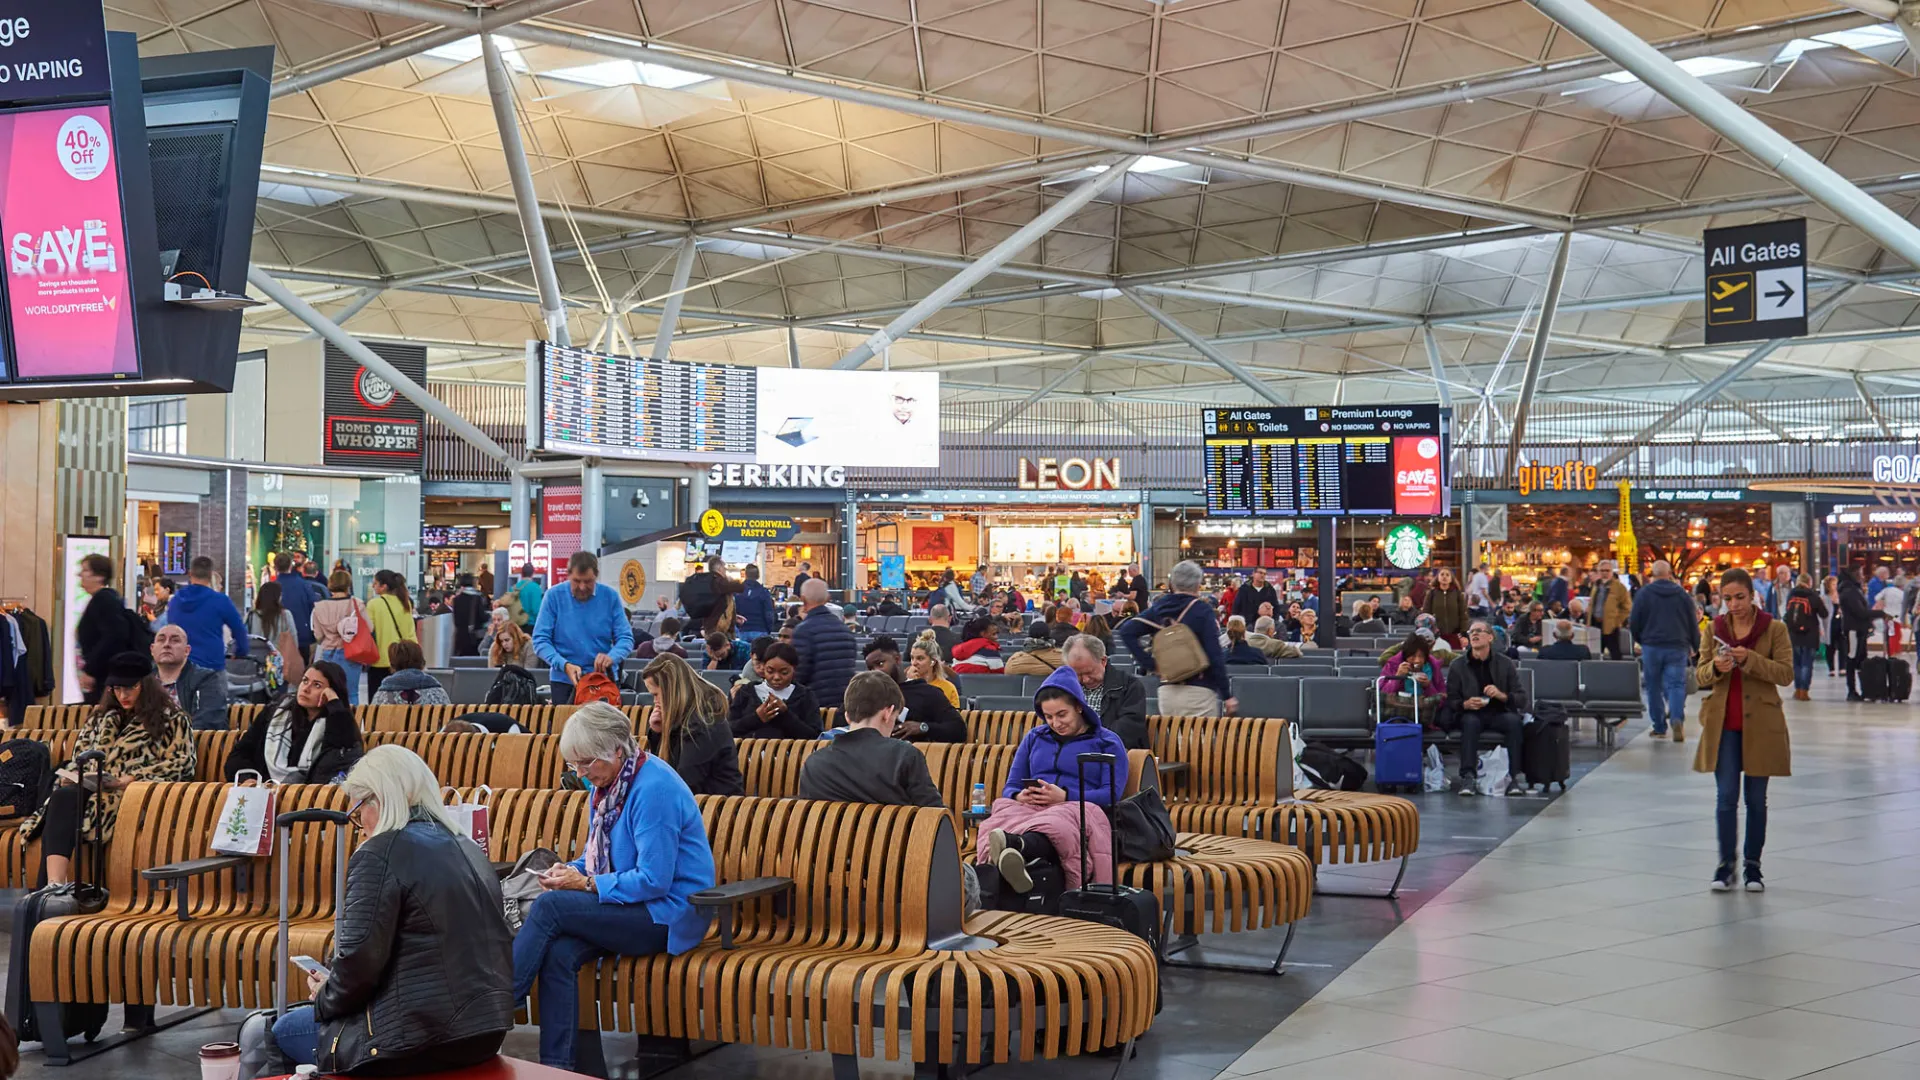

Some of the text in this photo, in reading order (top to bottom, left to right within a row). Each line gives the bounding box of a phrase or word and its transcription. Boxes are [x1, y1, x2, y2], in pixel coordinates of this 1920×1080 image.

[14, 58, 83, 82] VAPING
[65, 129, 101, 149] 40%
[71, 149, 94, 164] Off
[12, 227, 110, 270] SAVE
[1710, 242, 1801, 267] All Gates
[38, 280, 60, 288] Savings
[68, 278, 97, 286] thousands
[53, 287, 78, 296] products
[1230, 411, 1272, 420] All Gates
[1331, 408, 1413, 419] Premium Lounge
[335, 422, 418, 436] HOME OF THE
[1257, 422, 1289, 432] Toilets
[335, 433, 418, 449] WHOPPER
[769, 465, 846, 488] KING
[1018, 457, 1120, 490] LEON
[1397, 468, 1437, 485] SAVE
[1518, 460, 1597, 496] giraffe
[1644, 490, 1741, 501] all day friendly dining
[547, 502, 565, 511] travel
[725, 519, 792, 528] WEST CORNWALL
[740, 529, 765, 537] PASTY
[358, 568, 377, 576] nex
